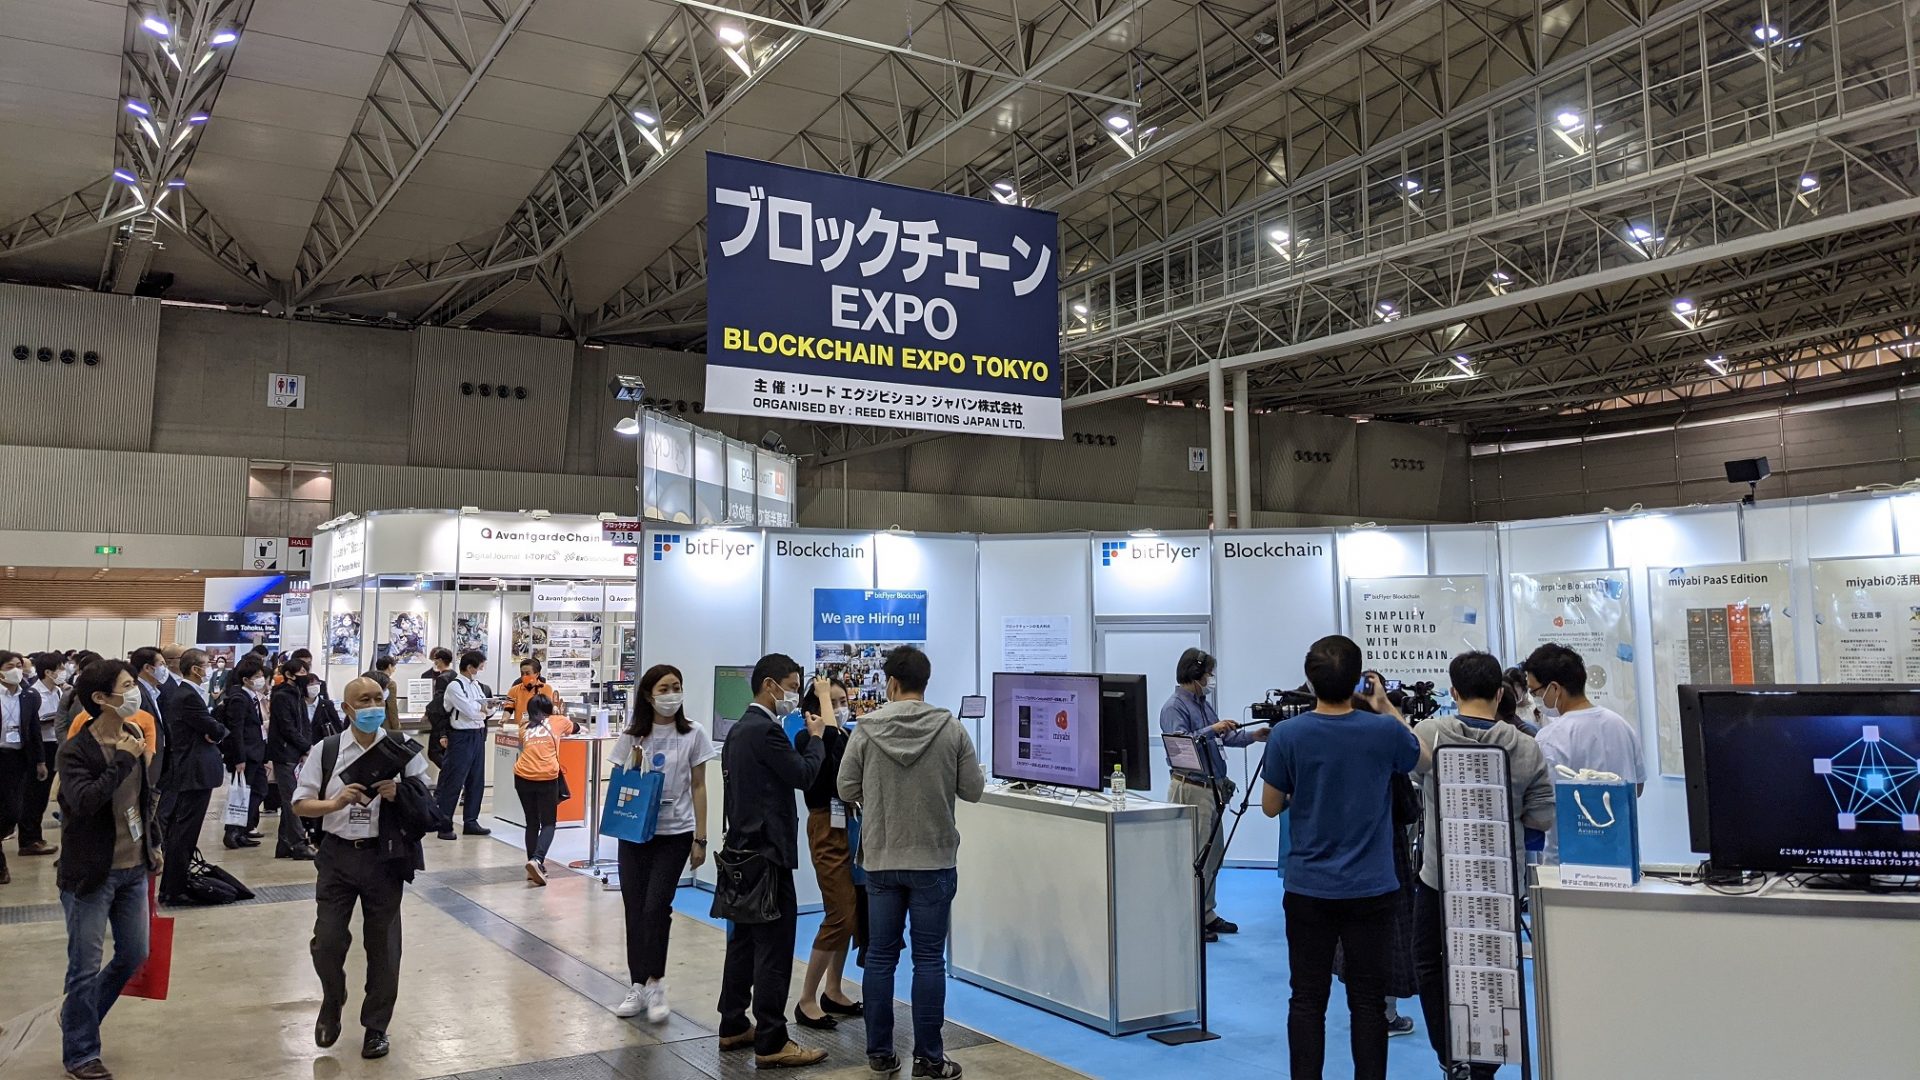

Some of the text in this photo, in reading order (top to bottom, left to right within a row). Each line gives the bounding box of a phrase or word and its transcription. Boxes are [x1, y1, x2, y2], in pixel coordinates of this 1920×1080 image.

[715, 186, 1051, 297] ブロックチェーン
[832, 284, 957, 341] EXPO
[723, 327, 1049, 382] BLOCKCHAIN EXPO TOKYO
[841, 387, 927, 408] エグジビション
[932, 395, 1024, 416] ジャパン株式会社
[752, 397, 826, 414] ORGANISED
[829, 404, 845, 416] BY
[855, 407, 886, 418] REED
[889, 409, 960, 425] EXHIBITIONS
[963, 416, 1000, 428] JAPAN
[1002, 419, 1026, 430] LTD.
[495, 530, 600, 543] AvantgardeChain
[685, 537, 755, 560] bitFlyer
[776, 540, 864, 559] Blockchain
[1131, 542, 1201, 563] bitFlyer
[1224, 541, 1323, 558] Blockchain
[298, 549, 307, 568] 1
[1668, 573, 1768, 588] miyabi PaaS Edition
[545, 594, 600, 602] AvantgardeChain
[1556, 595, 1582, 604] miyabi
[821, 612, 920, 627] We are Hiring !!!
[1365, 610, 1425, 621] SIMPLIFY
[1366, 624, 1437, 634] THE WORLD
[1366, 637, 1398, 647] WITH
[1367, 650, 1453, 660] BLOCKCHAIN.
[1489, 860, 1497, 893] SIMPLIF
[1487, 972, 1495, 986] THE
